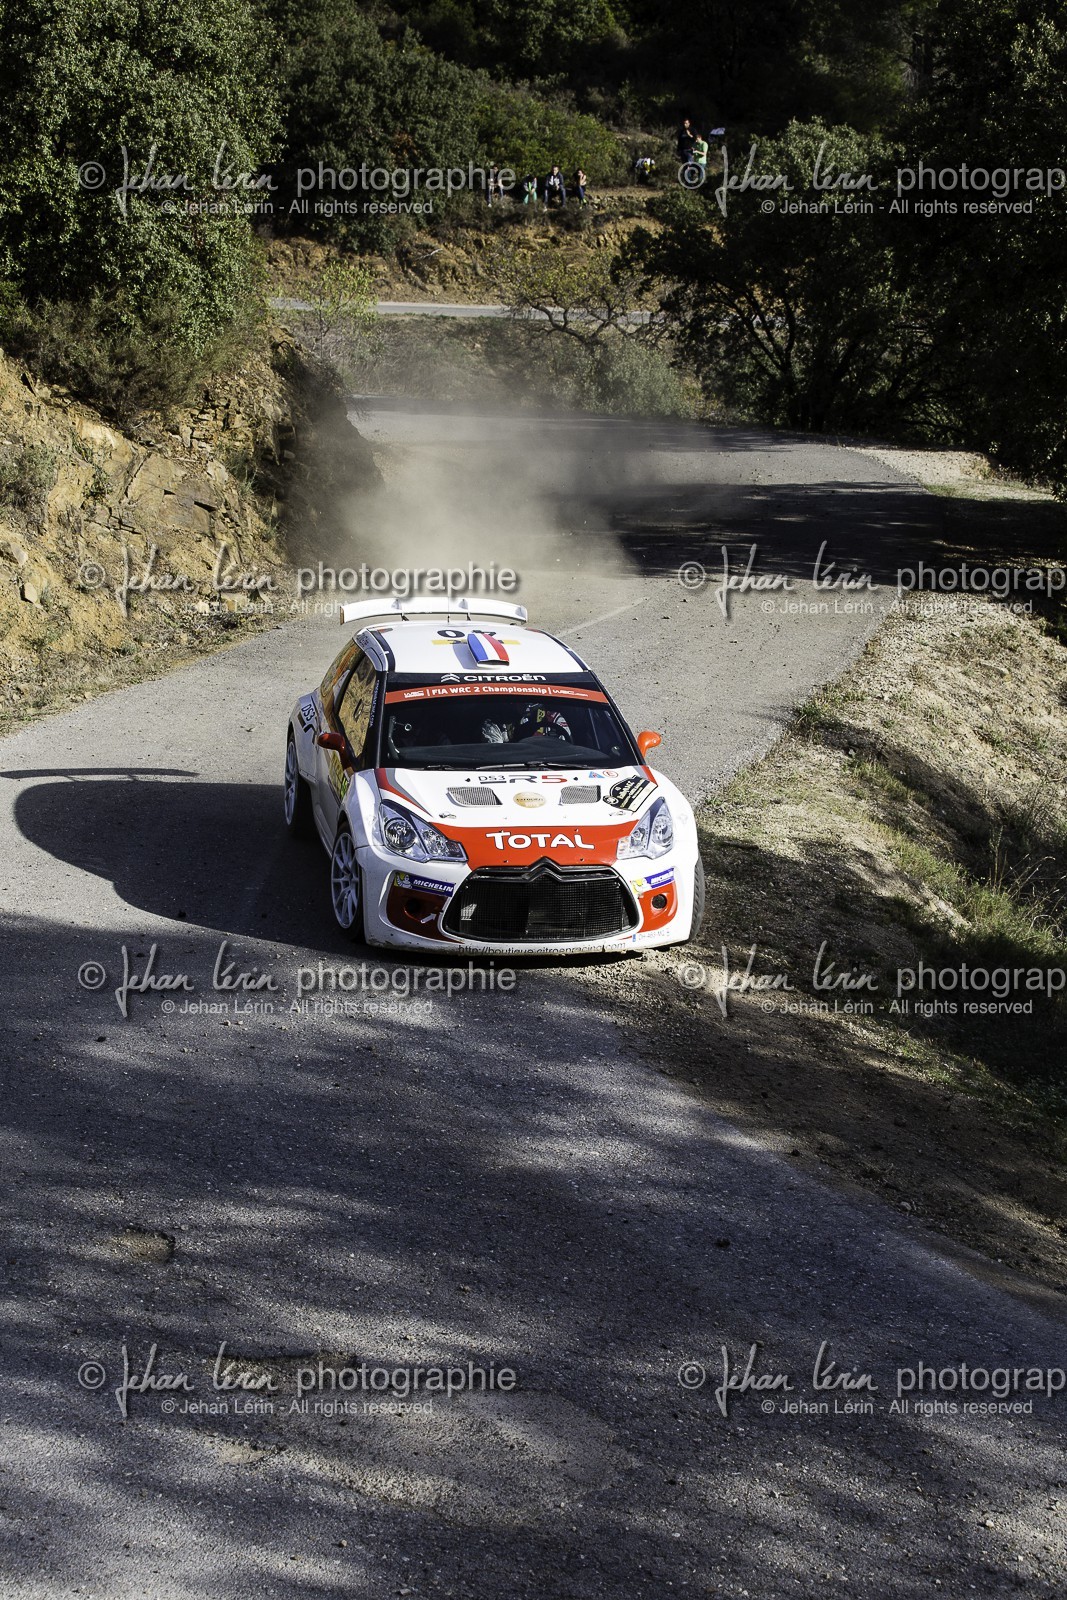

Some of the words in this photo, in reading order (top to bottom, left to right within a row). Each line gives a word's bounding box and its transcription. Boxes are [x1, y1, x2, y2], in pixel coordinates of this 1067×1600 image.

[432, 687, 447, 695] FIA
[482, 685, 546, 695] Championship
[301, 703, 315, 721] DS3
[486, 831, 595, 850] TOTAL
[413, 879, 454, 892] MICHELIN
